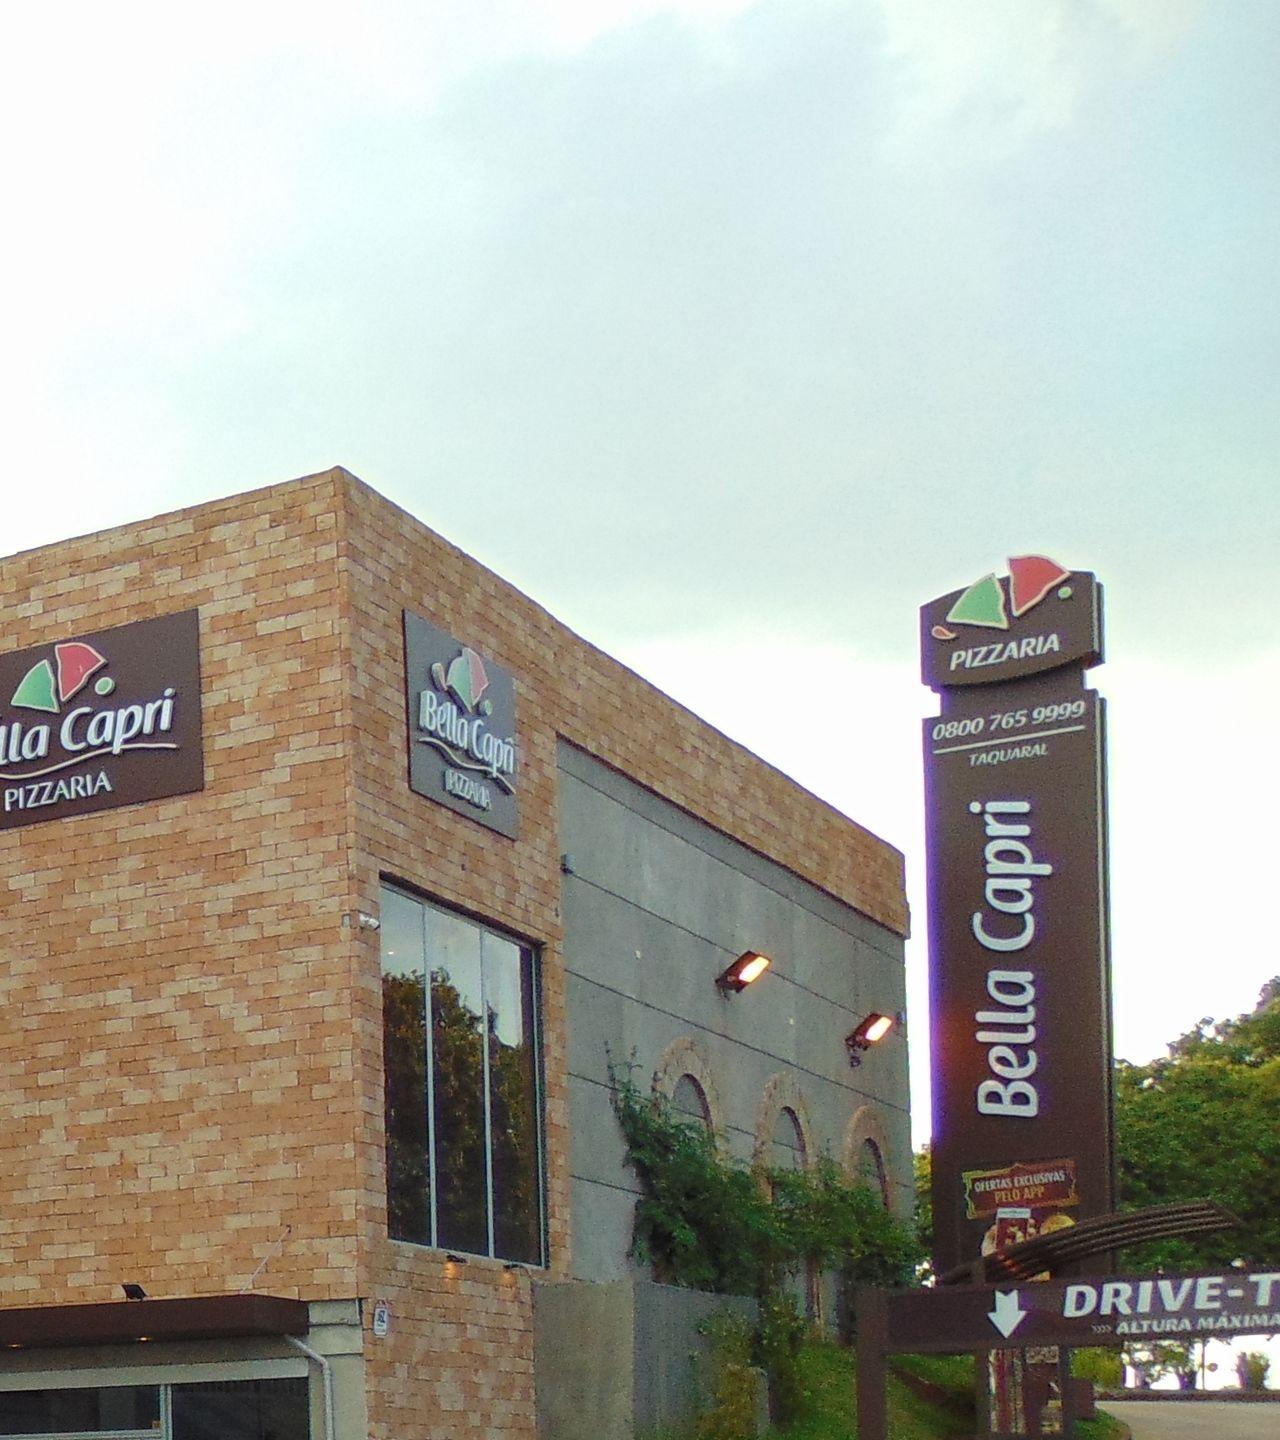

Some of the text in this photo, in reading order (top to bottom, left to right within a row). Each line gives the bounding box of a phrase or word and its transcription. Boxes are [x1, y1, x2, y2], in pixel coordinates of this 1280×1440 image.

[950, 633, 1060, 671] PIZZARIA
[60, 688, 176, 754] Capri
[419, 690, 514, 778] Bella Capri
[932, 700, 1085, 740] 0800 765 9999
[969, 743, 1048, 767] TAQUARAL
[4, 771, 112, 811] PIZZARIA
[445, 769, 491, 810] PIZZARIA
[969, 800, 1053, 1117] Bella Capri
[974, 1170, 1065, 1192] OFERTAS EXCLUSIVAS
[994, 1186, 1045, 1203] PELO APP
[1116, 1318, 1190, 1334] ALTURA
